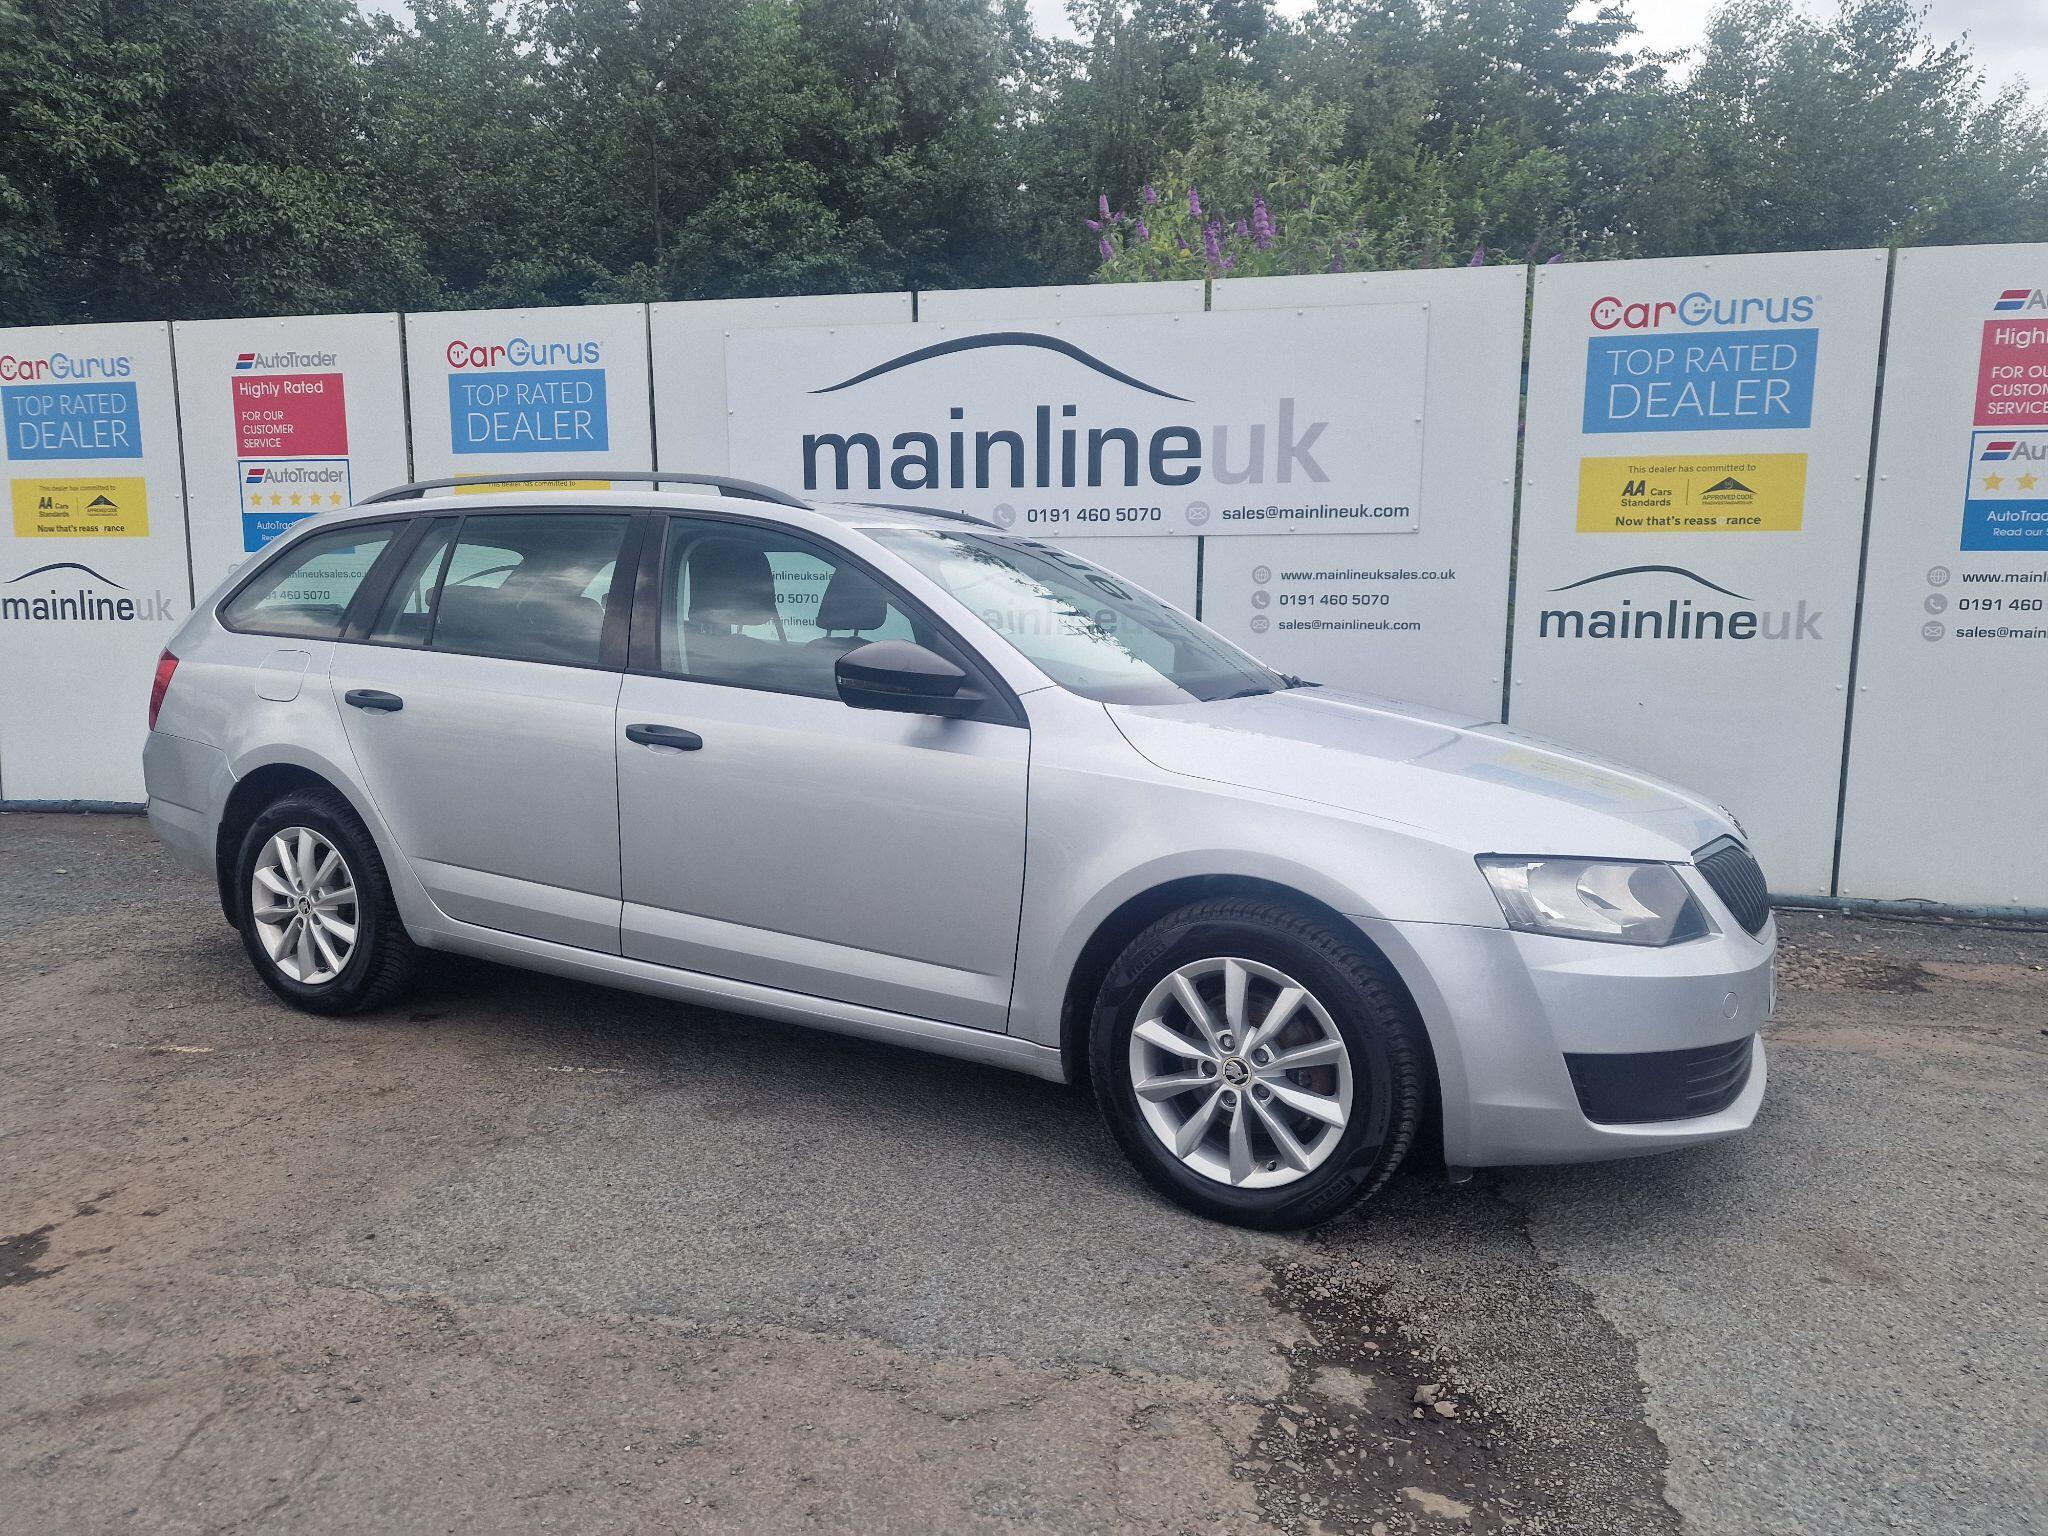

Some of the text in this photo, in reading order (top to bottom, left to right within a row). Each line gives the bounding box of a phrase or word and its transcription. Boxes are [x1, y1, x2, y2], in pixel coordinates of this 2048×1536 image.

[2026, 289, 2048, 310] A
[1590, 291, 1814, 330] CarGurus
[255, 351, 337, 369] AutoTrader
[447, 338, 600, 368] CarGurus
[1607, 344, 1797, 376] TOP RATED
[0, 353, 131, 381] CarGurus
[1992, 366, 2024, 379] FOR
[240, 380, 324, 398] Highly Rated
[461, 382, 592, 406] TOP RATED
[12, 393, 127, 416] TOP RATED
[1608, 379, 1791, 419] DEALER
[242, 410, 284, 421] FOR OUR
[243, 424, 294, 434] CUSTOMER
[468, 410, 594, 442] DEALER
[18, 420, 129, 450] DEALER
[244, 438, 282, 448] SERVICE
[2011, 440, 2048, 461] Au
[264, 468, 343, 484] AutoTrader
[1628, 463, 1757, 473] This dealer has committed to
[1622, 480, 1672, 496] AA Cars
[38, 497, 53, 510] AA
[1621, 498, 1671, 507] Standards
[1027, 507, 1161, 522] 0191 460 5070
[1222, 504, 1409, 521] sales@mainlineuk.com
[1615, 516, 1643, 526] Now
[1646, 515, 1681, 525] that's
[37, 525, 54, 533] Now
[56, 524, 78, 532] that's
[1993, 528, 2022, 537] Read
[2025, 529, 2043, 537] our
[1281, 569, 1456, 581] www.mainlineuksales.co.uk
[280, 590, 301, 600] 460
[303, 590, 330, 600] 5070
[788, 593, 819, 604] 5070
[1279, 594, 1390, 606] 0191 460 5070
[2, 589, 175, 621] mainlineuk
[1959, 598, 2042, 611] 0191 460
[1278, 619, 1421, 631] sales@mainlineuk.com
[1539, 600, 1824, 640] mainlineuk
